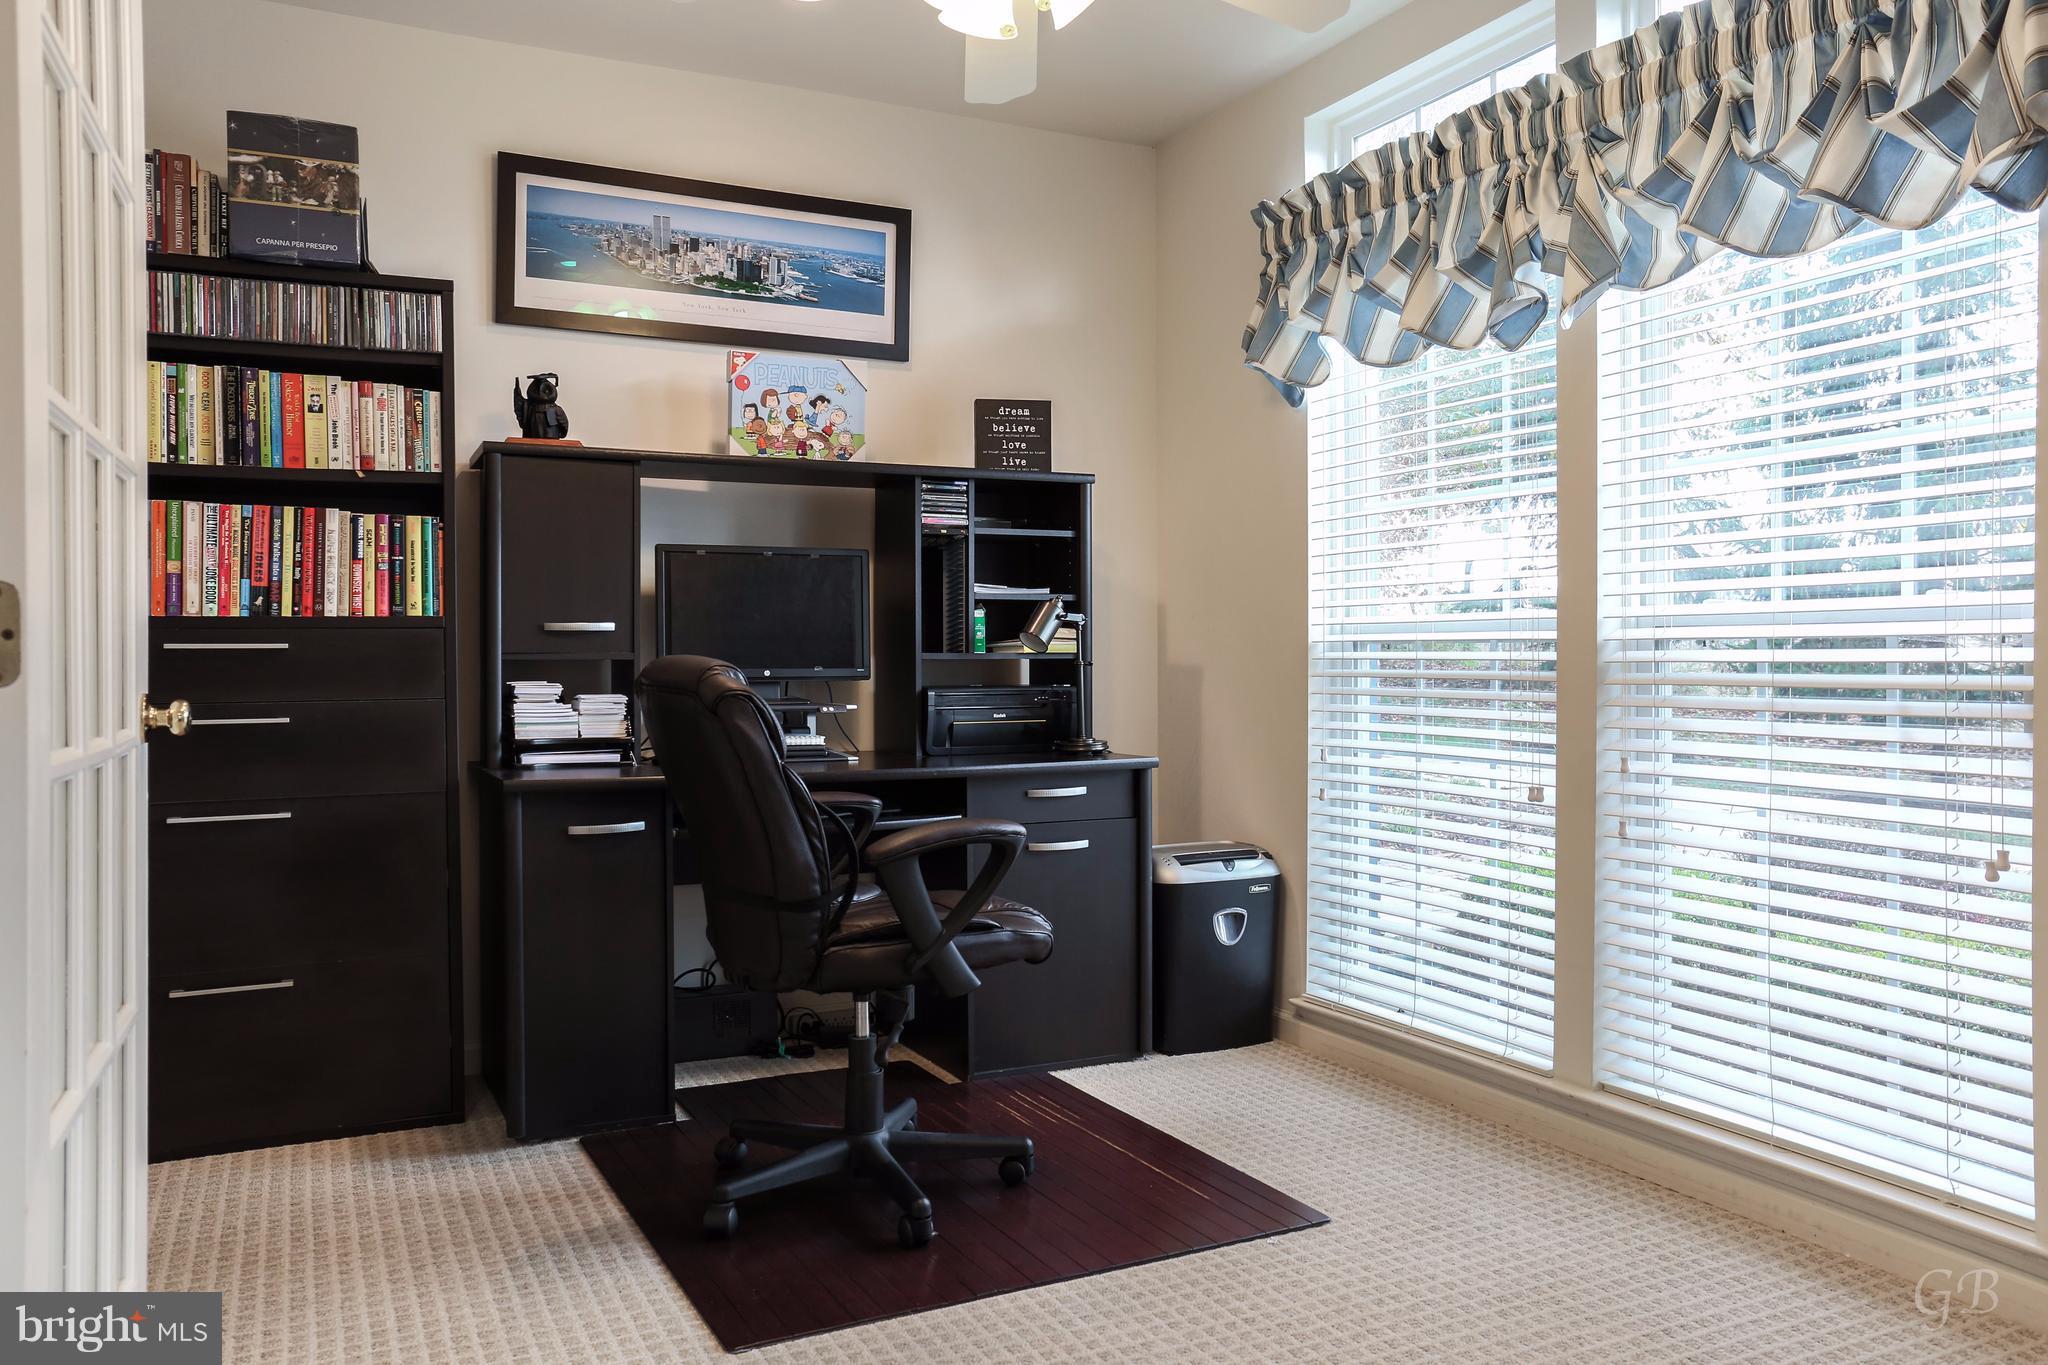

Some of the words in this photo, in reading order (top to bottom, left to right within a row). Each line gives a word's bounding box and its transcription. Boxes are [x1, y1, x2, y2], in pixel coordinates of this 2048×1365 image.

[256, 238, 291, 247] CAPANNA
[306, 242, 338, 252] PRESEPIO
[202, 372, 210, 389] GOOD
[227, 370, 236, 382] THE
[753, 362, 840, 391] PEANUTS
[247, 381, 255, 404] TWILIGHT
[285, 380, 293, 402] Jokes
[202, 392, 210, 411] CLEAN
[227, 383, 236, 422] DISCOVERERS
[414, 401, 422, 421] CRUEL
[998, 406, 1030, 416] dream
[248, 405, 256, 420] ZONE
[202, 414, 210, 433] JOKES
[286, 413, 294, 436] Humor
[992, 424, 1036, 432] believe
[414, 439, 424, 461] IDIOTS
[1002, 440, 1027, 449] love
[1002, 456, 1027, 466] live
[170, 502, 179, 537] Unexplained
[207, 506, 217, 514] THE
[206, 514, 217, 547] ULTIMATE
[273, 519, 281, 540] Blonde
[206, 567, 217, 584] JOKE
[255, 551, 264, 582] JOKES
[353, 564, 362, 592] DOWNSIZE
[206, 586, 217, 604] BOOK
[353, 594, 362, 608] THIS!
